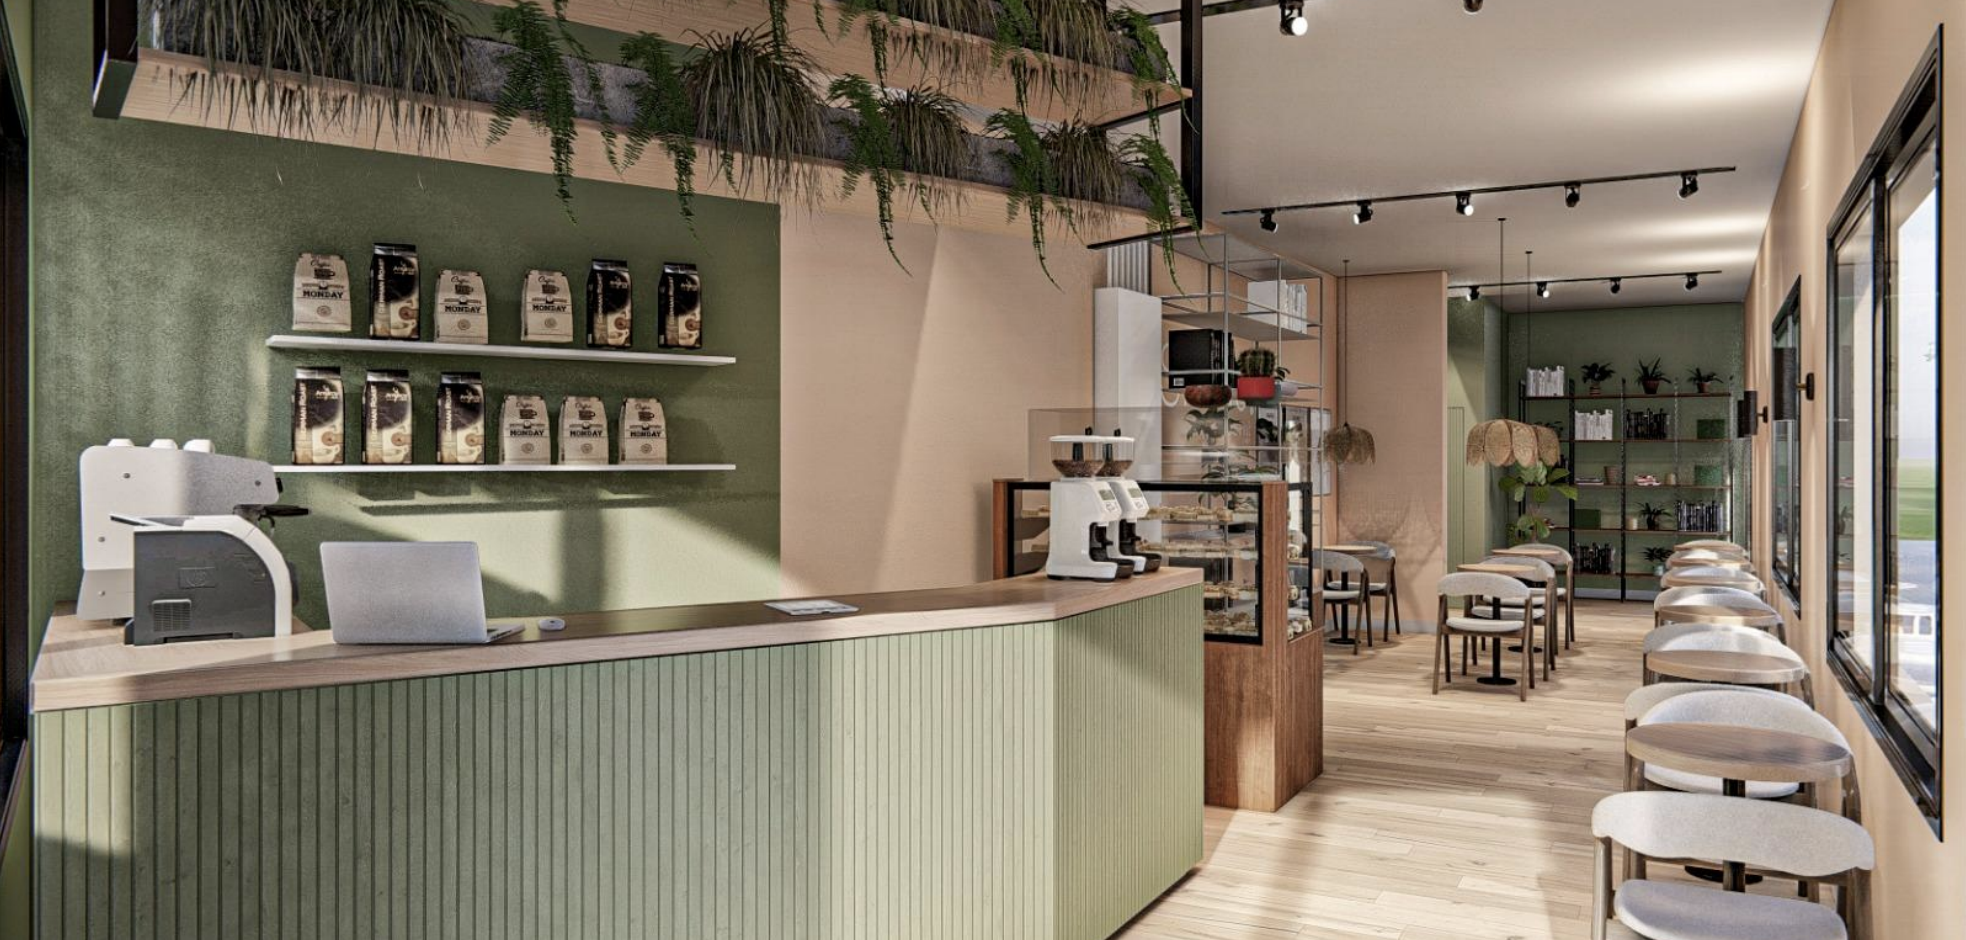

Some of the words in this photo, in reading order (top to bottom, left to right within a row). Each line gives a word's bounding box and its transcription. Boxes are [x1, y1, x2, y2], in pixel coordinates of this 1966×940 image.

[302, 290, 344, 299] MONDAY
[444, 305, 481, 313] MONDAY
[532, 304, 567, 313] MONDAY
